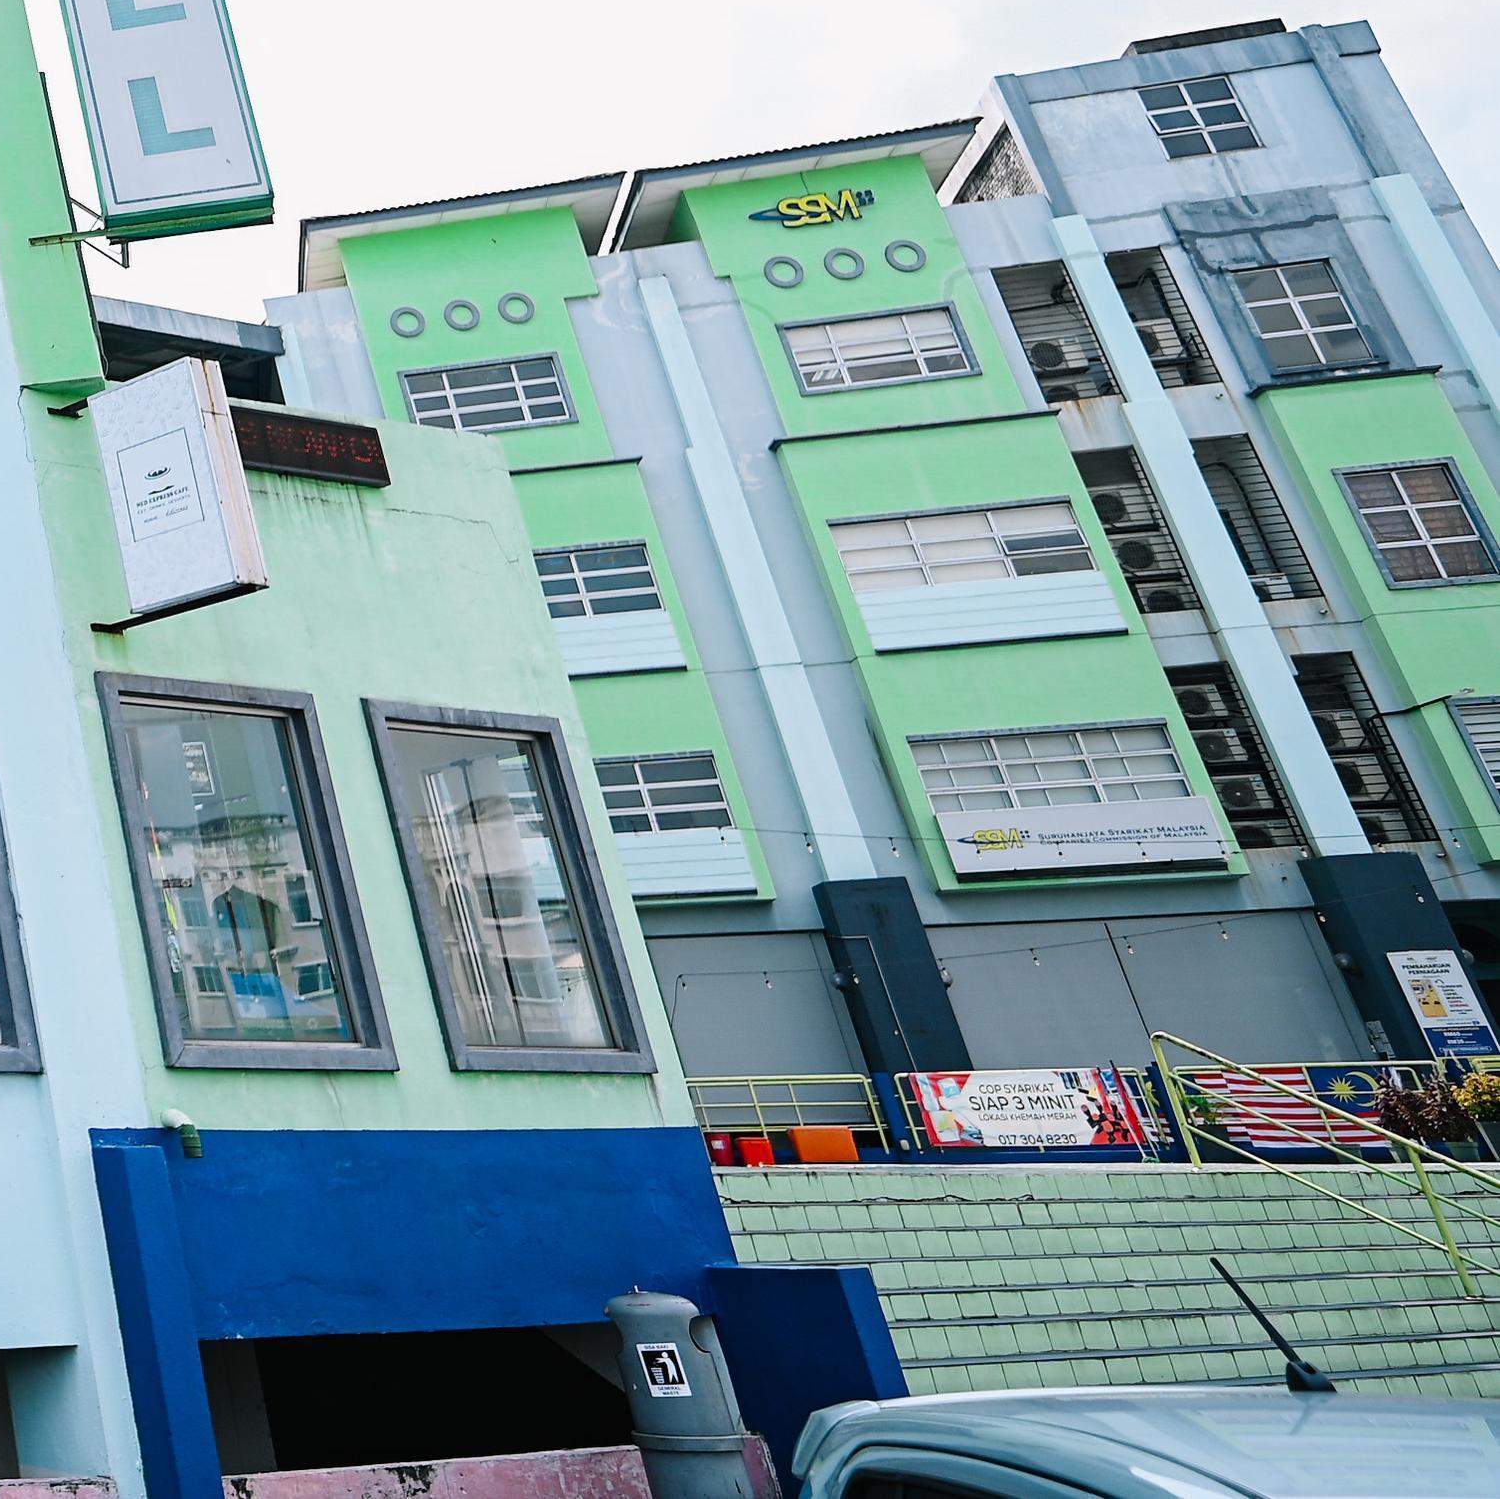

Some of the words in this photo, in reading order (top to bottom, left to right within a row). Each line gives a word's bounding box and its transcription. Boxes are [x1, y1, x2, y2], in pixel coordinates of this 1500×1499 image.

[777, 188, 863, 229] SSM
[972, 827, 1024, 851] SSM
[1037, 830, 1106, 840] SURUHANJAYA
[1107, 827, 1155, 837] SYARIKAT
[1156, 824, 1206, 834] MALAYSIA
[1092, 834, 1148, 843] COMMISSION
[1163, 831, 1209, 839] MALAYSIA
[978, 1084, 1001, 1095] COP
[1003, 1082, 1056, 1094] SYARIKAT
[968, 1095, 1009, 1111] SIAP
[1012, 1095, 1025, 1111] 3
[1027, 1094, 1076, 1110] MINIT
[978, 1113, 1009, 1122] LOKASI
[1010, 1112, 1046, 1121] KHEMAH
[1047, 1112, 1078, 1121] MERAH
[997, 1134, 1017, 1145] 017
[1018, 1134, 1044, 1145] 304
[1045, 1133, 1078, 1145] 8230
